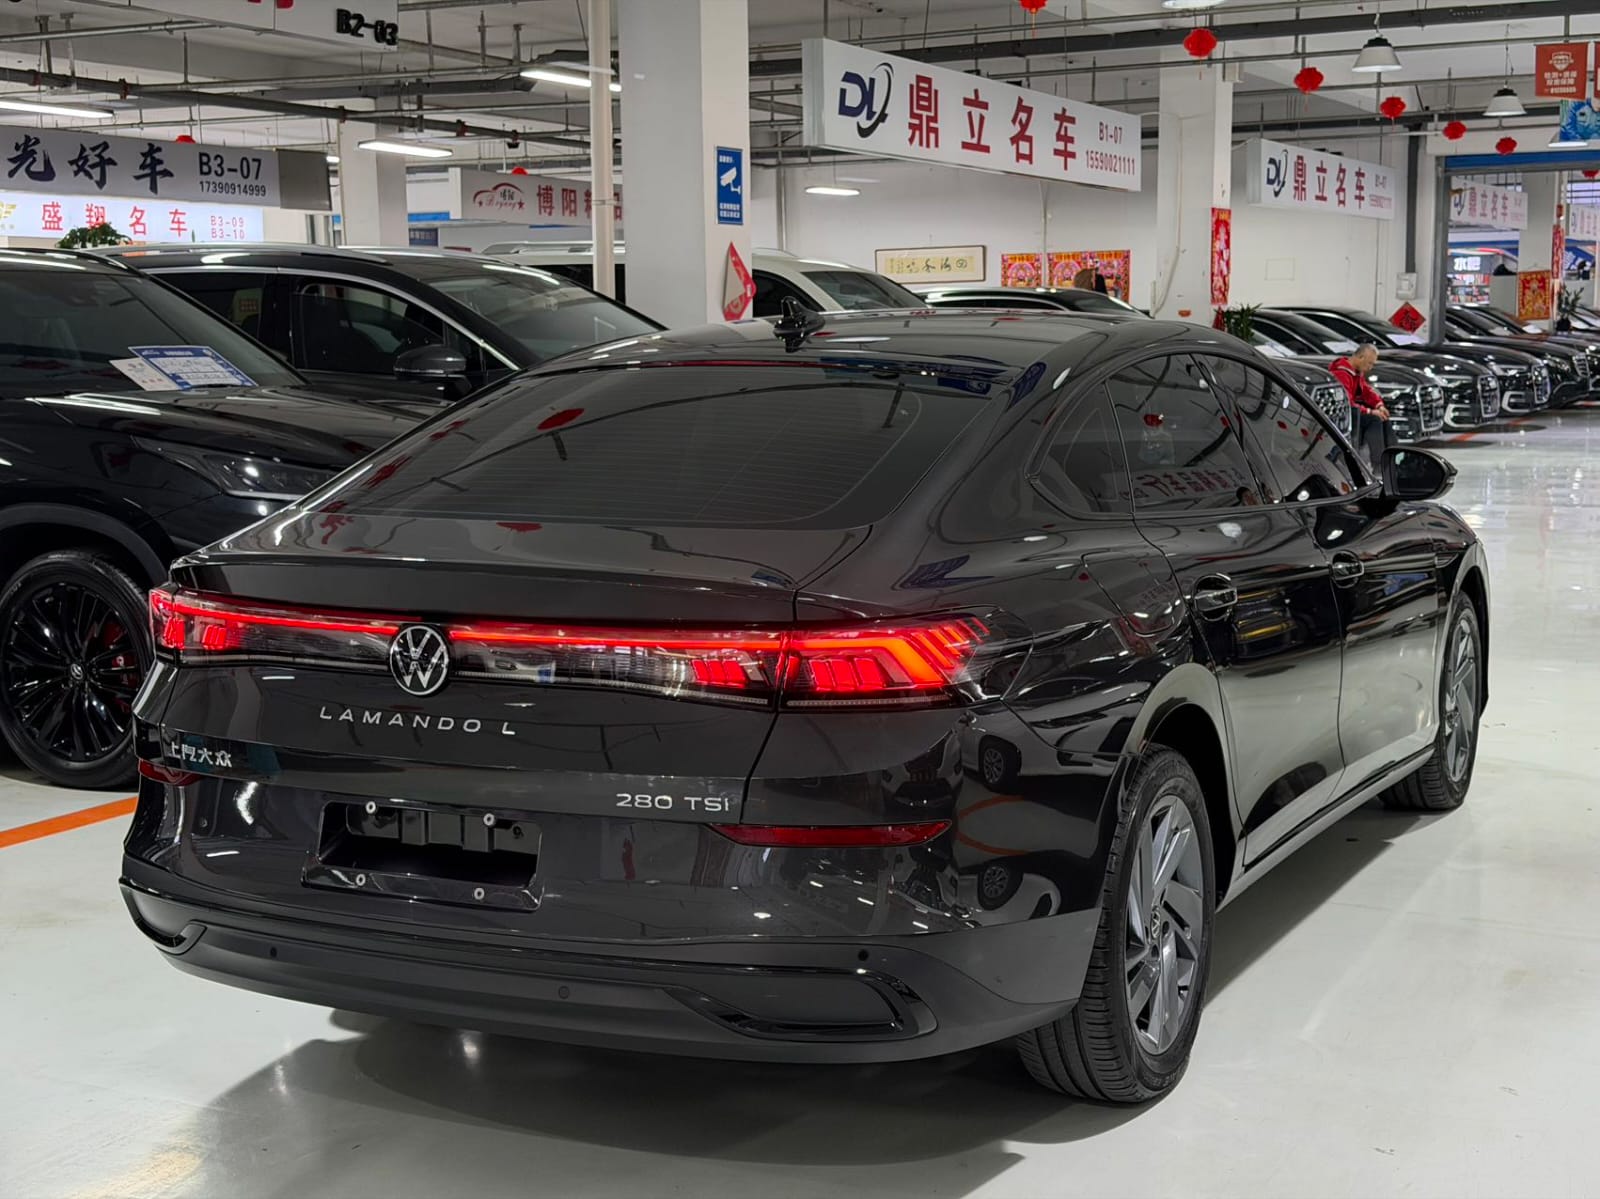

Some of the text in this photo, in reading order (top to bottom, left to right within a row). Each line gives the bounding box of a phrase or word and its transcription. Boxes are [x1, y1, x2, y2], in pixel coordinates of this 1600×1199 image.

[336, 8, 399, 46] B2-03
[908, 74, 1077, 171] 鼎立名车
[1098, 122, 1123, 145] B1-07
[7, 135, 175, 195] 光好车
[199, 152, 262, 180] B3-07
[1085, 149, 1135, 176] 15590021111
[199, 181, 267, 197] 17390914999
[1293, 155, 1366, 210] 鼎立名车
[41, 202, 188, 238] 盛翔名车
[210, 215, 245, 228] B3-09
[210, 228, 246, 240] B3-10
[319, 706, 516, 736] LAMANDO L
[167, 741, 233, 768] 上汽大众
[615, 793, 729, 812] 280 TSI
